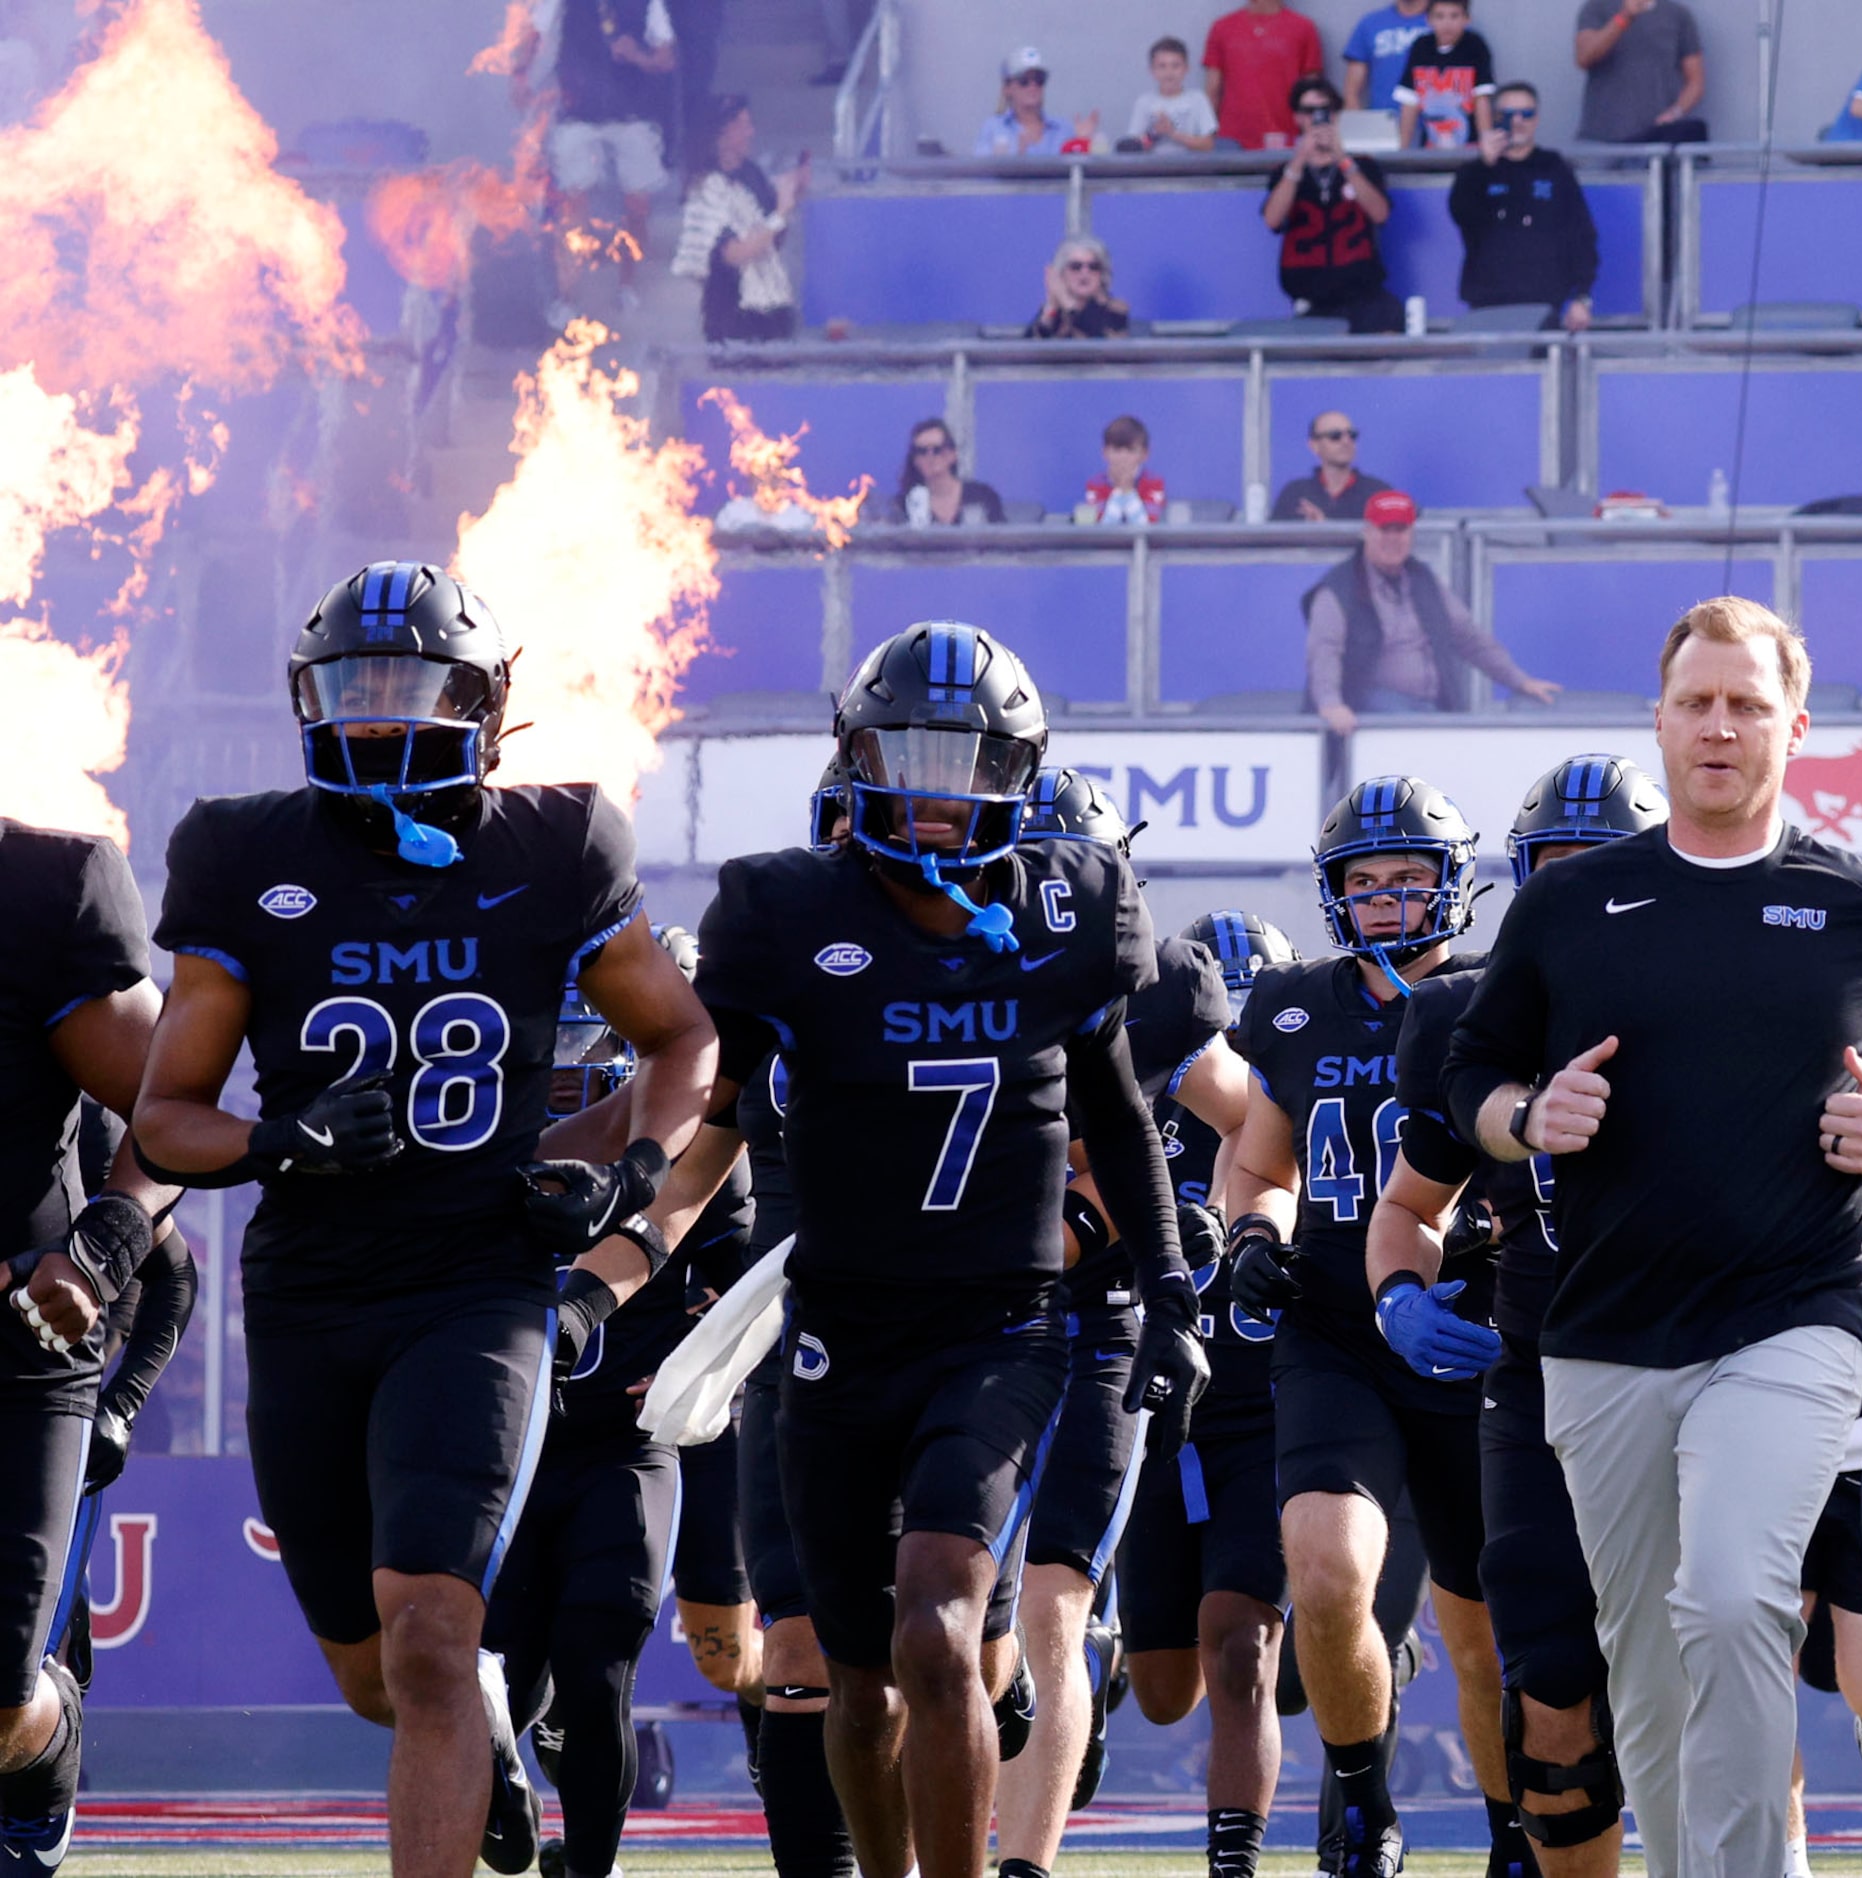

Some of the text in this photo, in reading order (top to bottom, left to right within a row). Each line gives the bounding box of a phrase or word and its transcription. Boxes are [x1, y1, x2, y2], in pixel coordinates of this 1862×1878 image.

[1282, 201, 1372, 268] 22
[1039, 878, 1077, 933] C
[1762, 904, 1827, 931] SMU
[331, 937, 479, 985] SMU
[883, 1000, 1019, 1043] SMU
[300, 992, 511, 1151] 28
[908, 1057, 1000, 1211] 7
